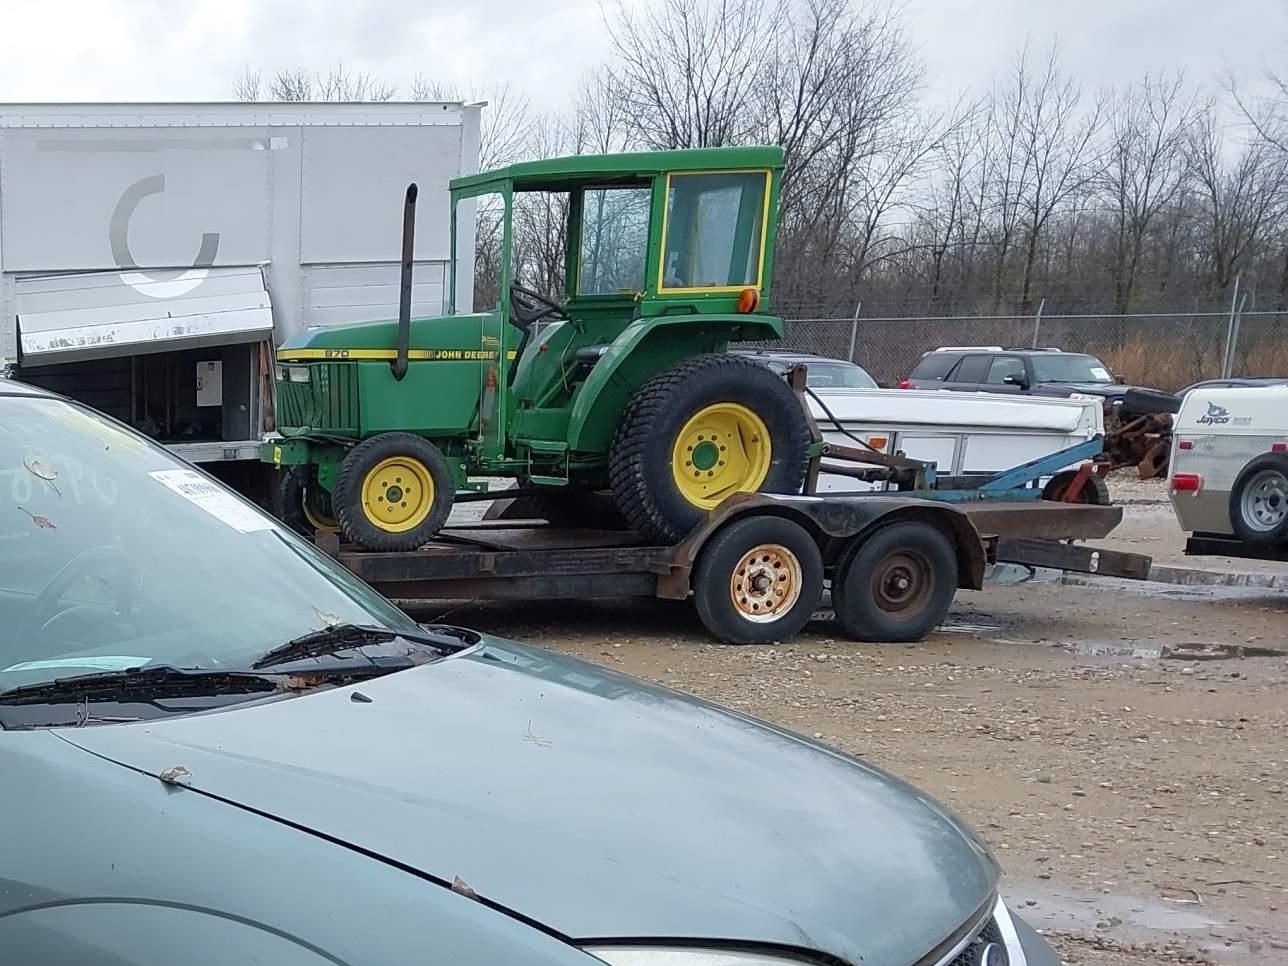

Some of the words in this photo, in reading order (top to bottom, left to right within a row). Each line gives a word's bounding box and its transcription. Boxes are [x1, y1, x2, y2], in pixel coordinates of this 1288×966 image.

[324, 350, 350, 358] 870
[435, 350, 462, 360] JOHN
[464, 350, 496, 360] DEERE
[1196, 414, 1230, 426] Jayco
